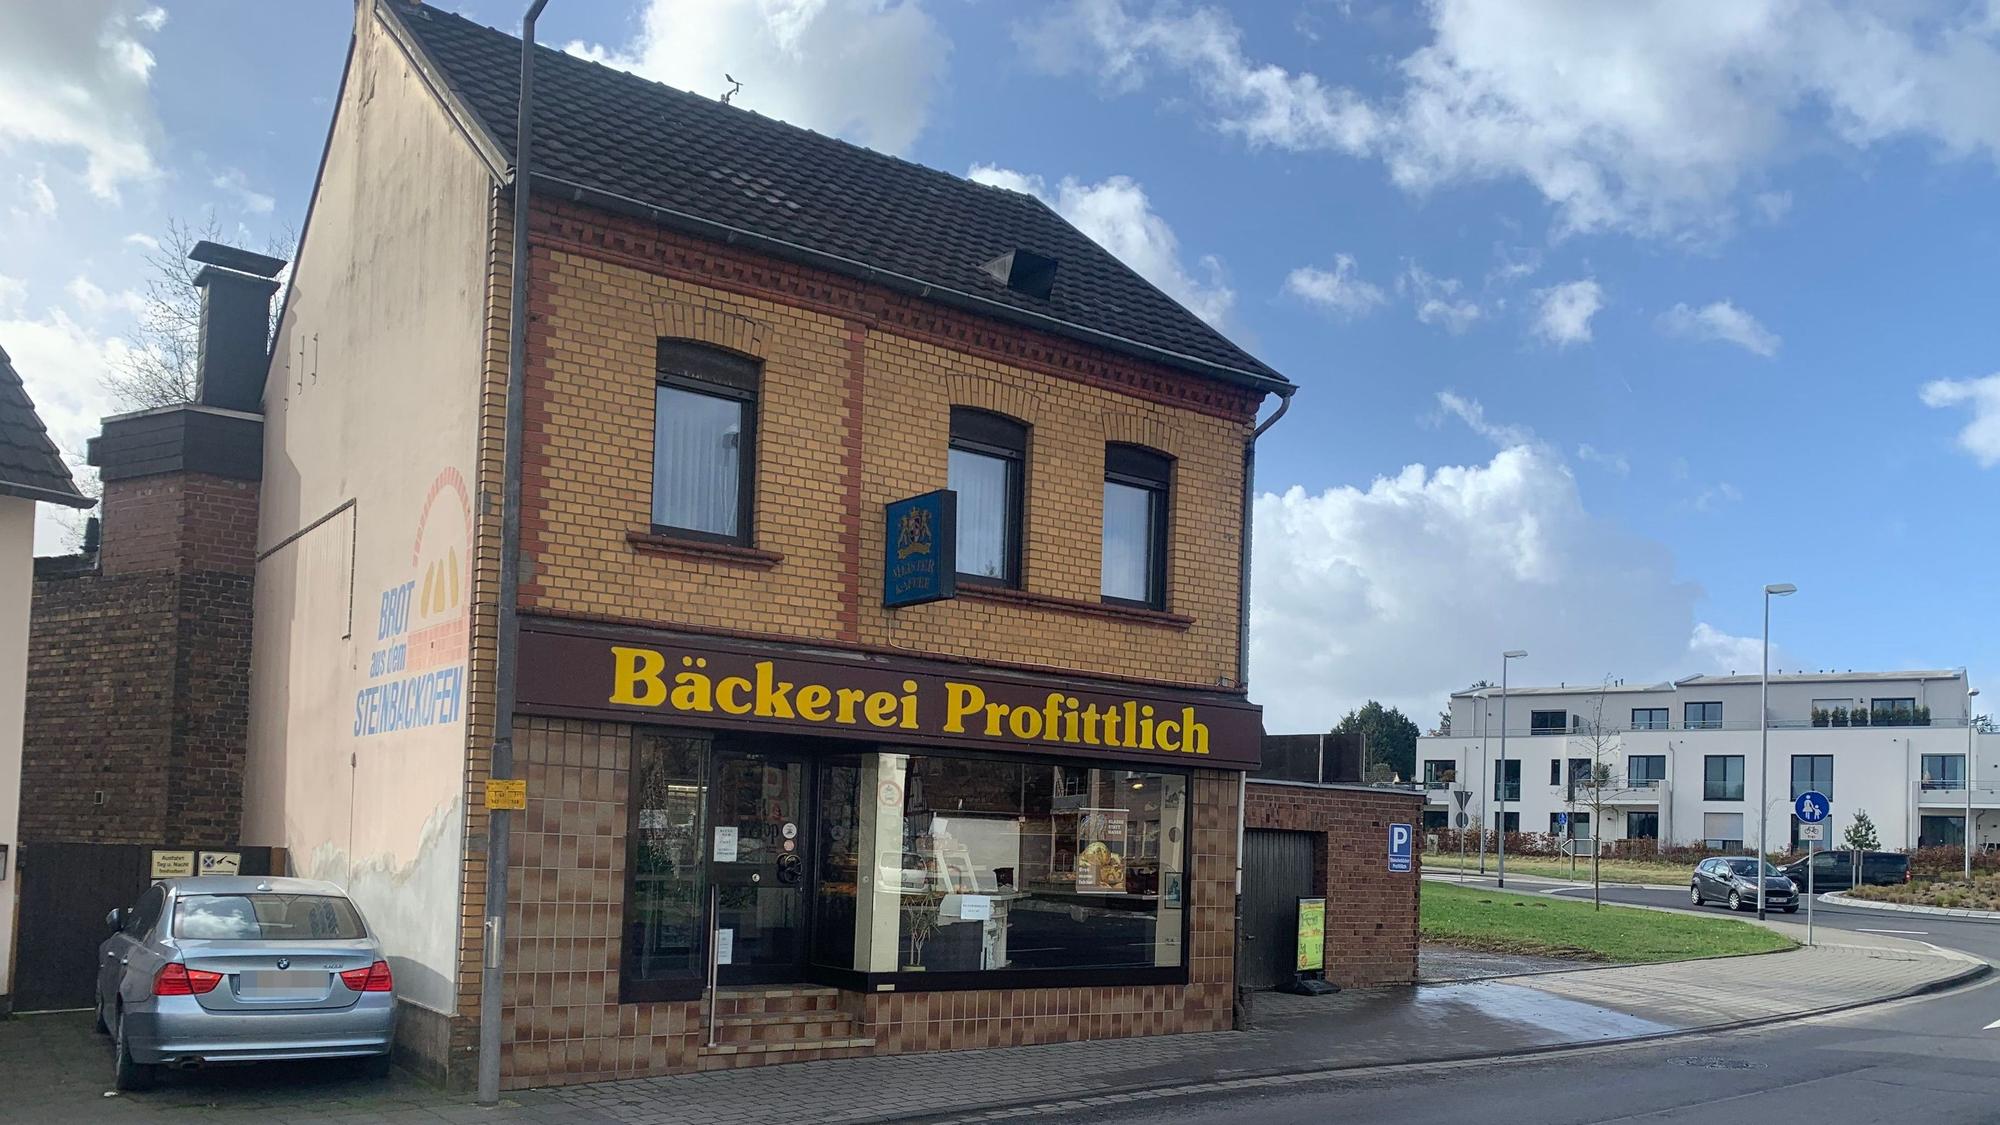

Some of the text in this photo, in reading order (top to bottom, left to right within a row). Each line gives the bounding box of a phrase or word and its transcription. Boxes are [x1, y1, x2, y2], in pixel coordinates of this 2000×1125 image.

[378, 580, 416, 640] BROT
[369, 640, 407, 678] aus dem
[354, 666, 464, 737] STEINBACKOFEN
[609, 646, 1210, 754] Bäckerei Profittlich
[1393, 827, 1408, 853] P
